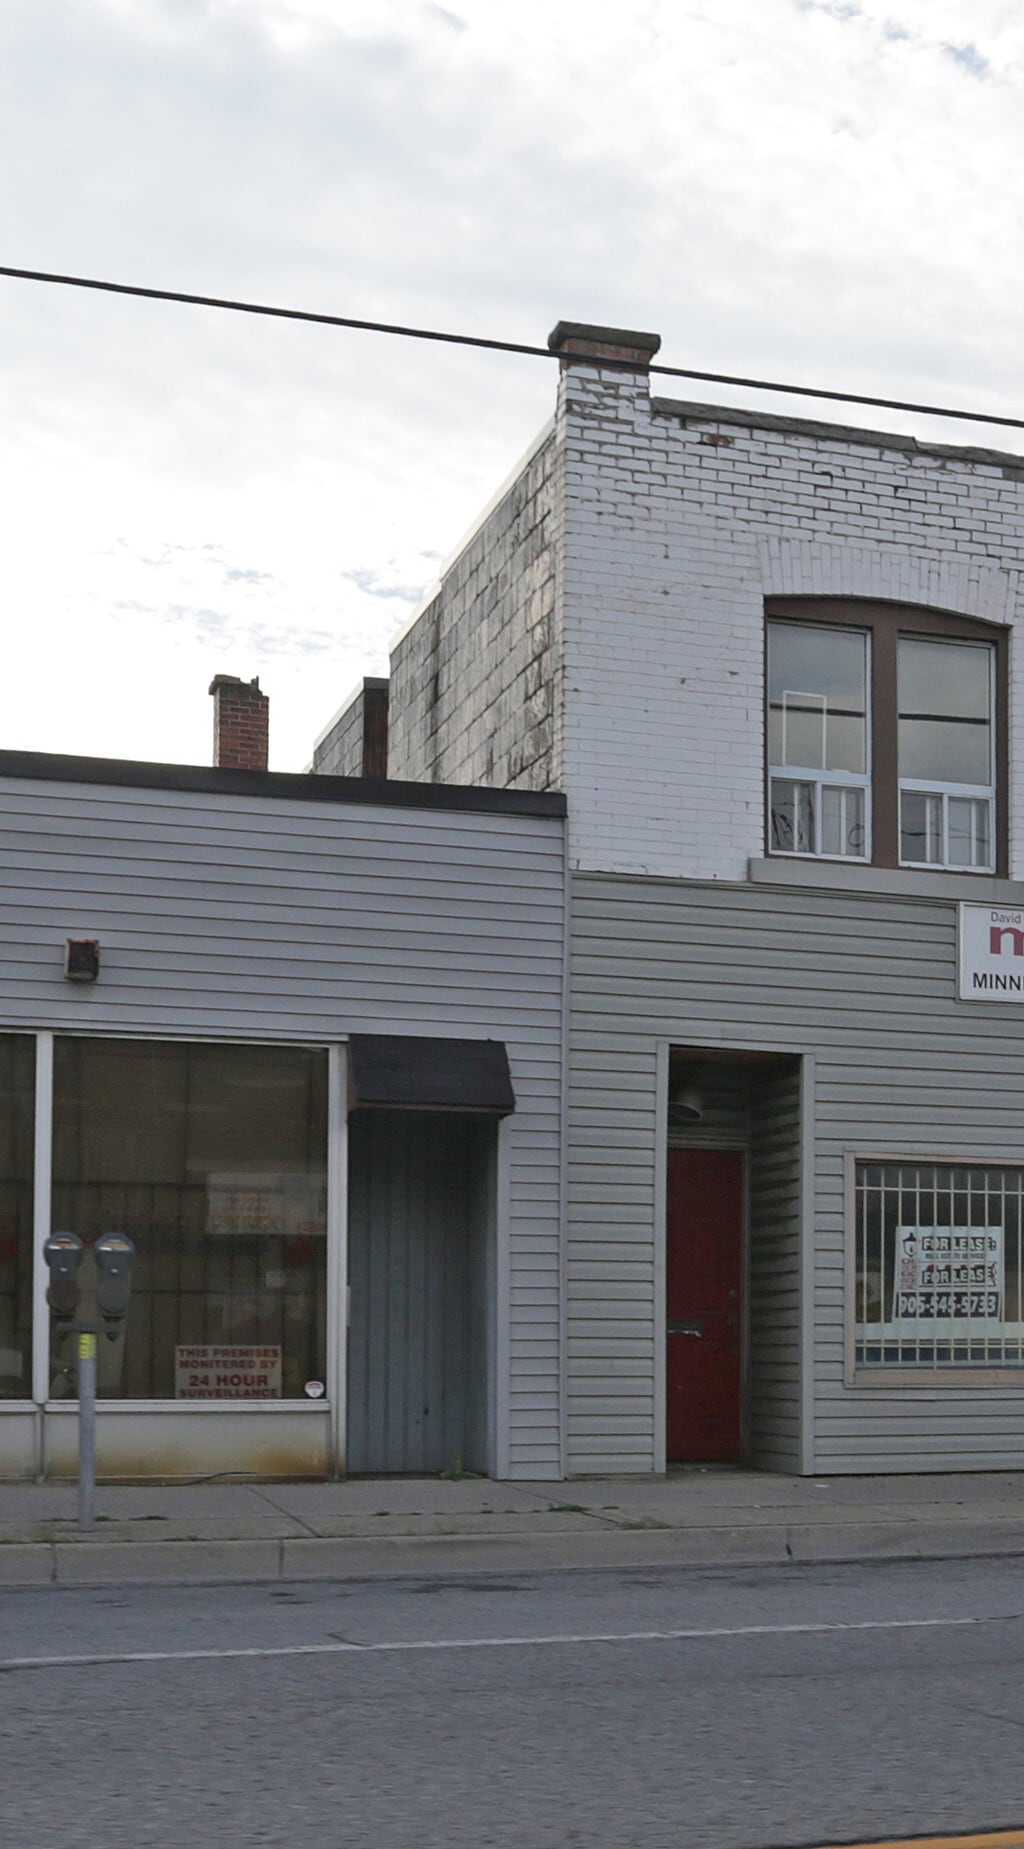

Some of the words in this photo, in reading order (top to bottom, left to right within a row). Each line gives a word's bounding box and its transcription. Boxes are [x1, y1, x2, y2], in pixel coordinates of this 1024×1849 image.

[990, 911, 1021, 924] David
[923, 1237, 950, 1250] FOR
[953, 1237, 993, 1251] LEASE
[923, 1270, 950, 1284] FOR
[953, 1269, 993, 1283] LEASE
[179, 1348, 209, 1358] THIS
[212, 1348, 279, 1358] PREMISES
[260, 1359, 278, 1369] BY
[188, 1374, 210, 1387] 24
[216, 1374, 269, 1387] HOUR
[179, 1388, 279, 1399] SURVEILLANCE
